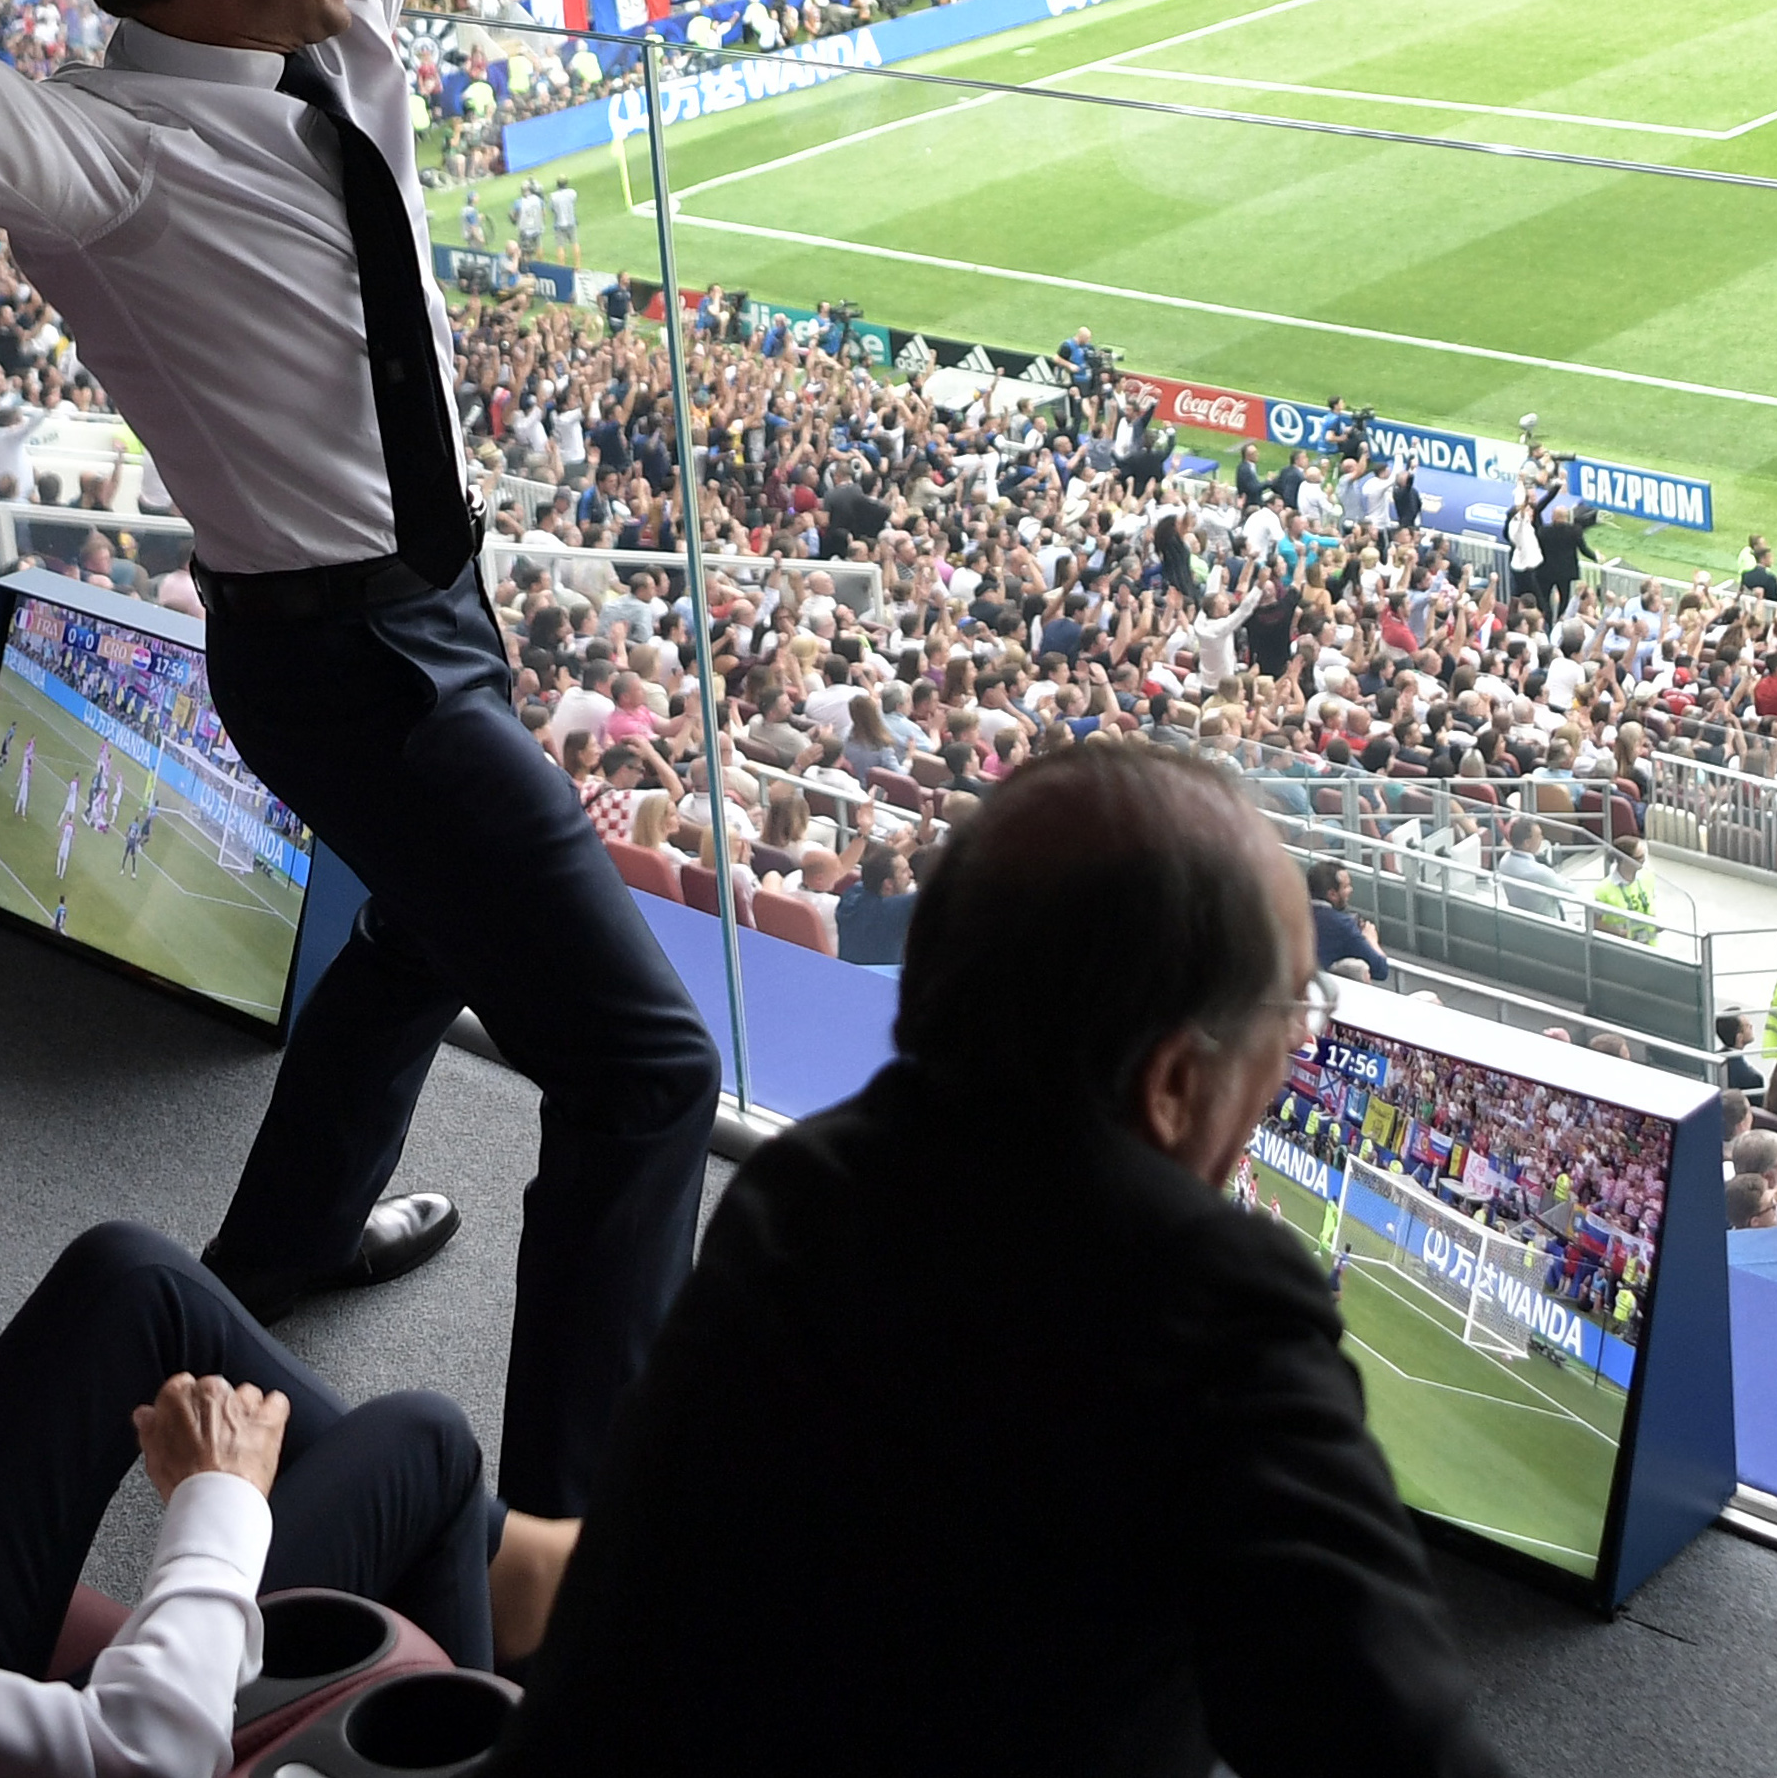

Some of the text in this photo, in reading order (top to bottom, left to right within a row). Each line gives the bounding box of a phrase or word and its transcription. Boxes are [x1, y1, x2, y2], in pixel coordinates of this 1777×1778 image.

[1580, 464, 1705, 525] GAZPROM
[35, 615, 59, 637] FRA
[103, 641, 128, 661] CRO
[155, 654, 185, 680] 17:56
[1325, 1044, 1379, 1079] 17:56
